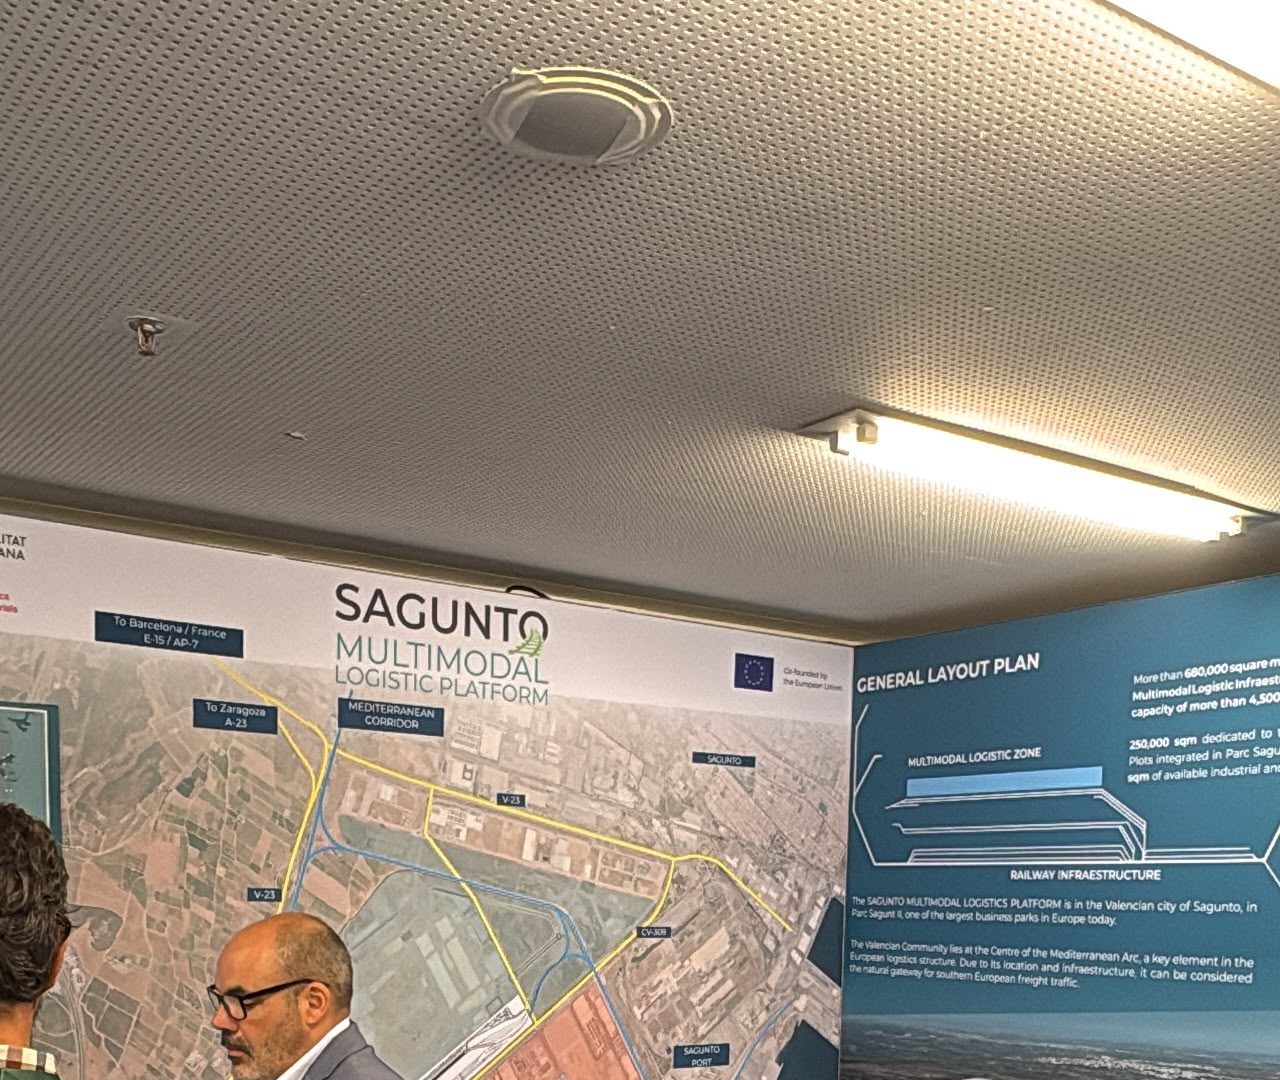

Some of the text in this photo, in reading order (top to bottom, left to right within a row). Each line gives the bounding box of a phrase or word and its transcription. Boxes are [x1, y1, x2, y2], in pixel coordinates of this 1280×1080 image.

[335, 583, 549, 642] SAGUNTO
[114, 616, 227, 640] To Barcelona France
[143, 633, 199, 649] E-15 AP-7
[336, 633, 549, 685] MULTIMODAL
[856, 652, 1040, 693] GENERAL LAYOUT PLAN
[1133, 674, 1158, 685] More
[1160, 671, 1183, 682] than
[1184, 663, 1229, 679] 680,000
[1230, 658, 1268, 674] square
[335, 665, 548, 706] LOGISTIC PLATFORM
[1132, 685, 1191, 702] Multimodal
[1192, 680, 1234, 696] Logistic
[205, 702, 266, 718] To Zaragoza
[348, 701, 435, 719] MEDITERRANEAN
[1131, 705, 1174, 718] capacity
[1175, 702, 1187, 714] of
[1189, 700, 1218, 712] more
[1220, 697, 1247, 709] than
[1248, 692, 1280, 707] 4,500
[224, 717, 248, 728] A-23
[364, 716, 419, 729] CORRIDOR
[1129, 737, 1170, 751] 250,000
[1173, 736, 1198, 749] sqm
[1201, 729, 1256, 744] dedicated
[1260, 729, 1273, 739] to
[707, 754, 742, 766] SAGUNTO
[908, 747, 1042, 768] MULTIMODAL LOGISTIC ZONE
[1128, 755, 1153, 767] Plots
[1155, 750, 1209, 765] integrated
[1211, 749, 1222, 760] in
[1225, 747, 1250, 760] Parc
[1127, 772, 1150, 785] sqm
[1151, 770, 1163, 782] of
[1163, 767, 1208, 780] available
[1210, 763, 1261, 778] industrial
[502, 795, 521, 805] V-23
[1010, 869, 1162, 881] RAILWAY INFRAESTRUCTURE
[253, 890, 275, 900] V-23
[867, 896, 905, 907] SAGUNTO
[906, 897, 961, 908] MULTIMODAL
[963, 897, 1008, 908] LOGISTICS
[1010, 898, 1062, 909] PLATFORM
[1074, 899, 1083, 909] in
[1086, 899, 1103, 910] the
[1105, 900, 1154, 911] Valencian
[1157, 900, 1176, 914] city
[1179, 900, 1191, 912] of
[1193, 901, 1243, 915] Sagunto,
[1246, 901, 1258, 913] in
[851, 908, 1117, 927] Parc Sagunt one the largest business parks in Europe today.
[865, 940, 901, 951] Valencian
[902, 942, 948, 955] Community
[949, 944, 963, 955] lies
[975, 945, 989, 956] the
[990, 946, 1020, 957] Centre
[1021, 946, 1032, 958] of
[1032, 947, 1048, 959] the
[1049, 949, 1120, 962] Mediterranean
[1152, 953, 1171, 967] key
[1172, 954, 1219, 967] element
[1221, 955, 1231, 967] in
[1234, 956, 1254, 968] the
[849, 951, 885, 963] European
[887, 953, 917, 965] logistics
[960, 957, 977, 968] Due
[1003, 960, 1038, 972] location
[1041, 962, 1059, 973] and
[1150, 969, 1169, 979] can
[1173, 968, 1187, 981] be
[1190, 970, 1253, 984] considered
[863, 965, 889, 975] natural
[890, 967, 923, 979] gateway
[936, 970, 973, 980] southern
[974, 971, 1016, 984] European
[1018, 974, 1048, 987] freight
[683, 1045, 721, 1056] SAGUNTO
[691, 1058, 712, 1067] PORT
